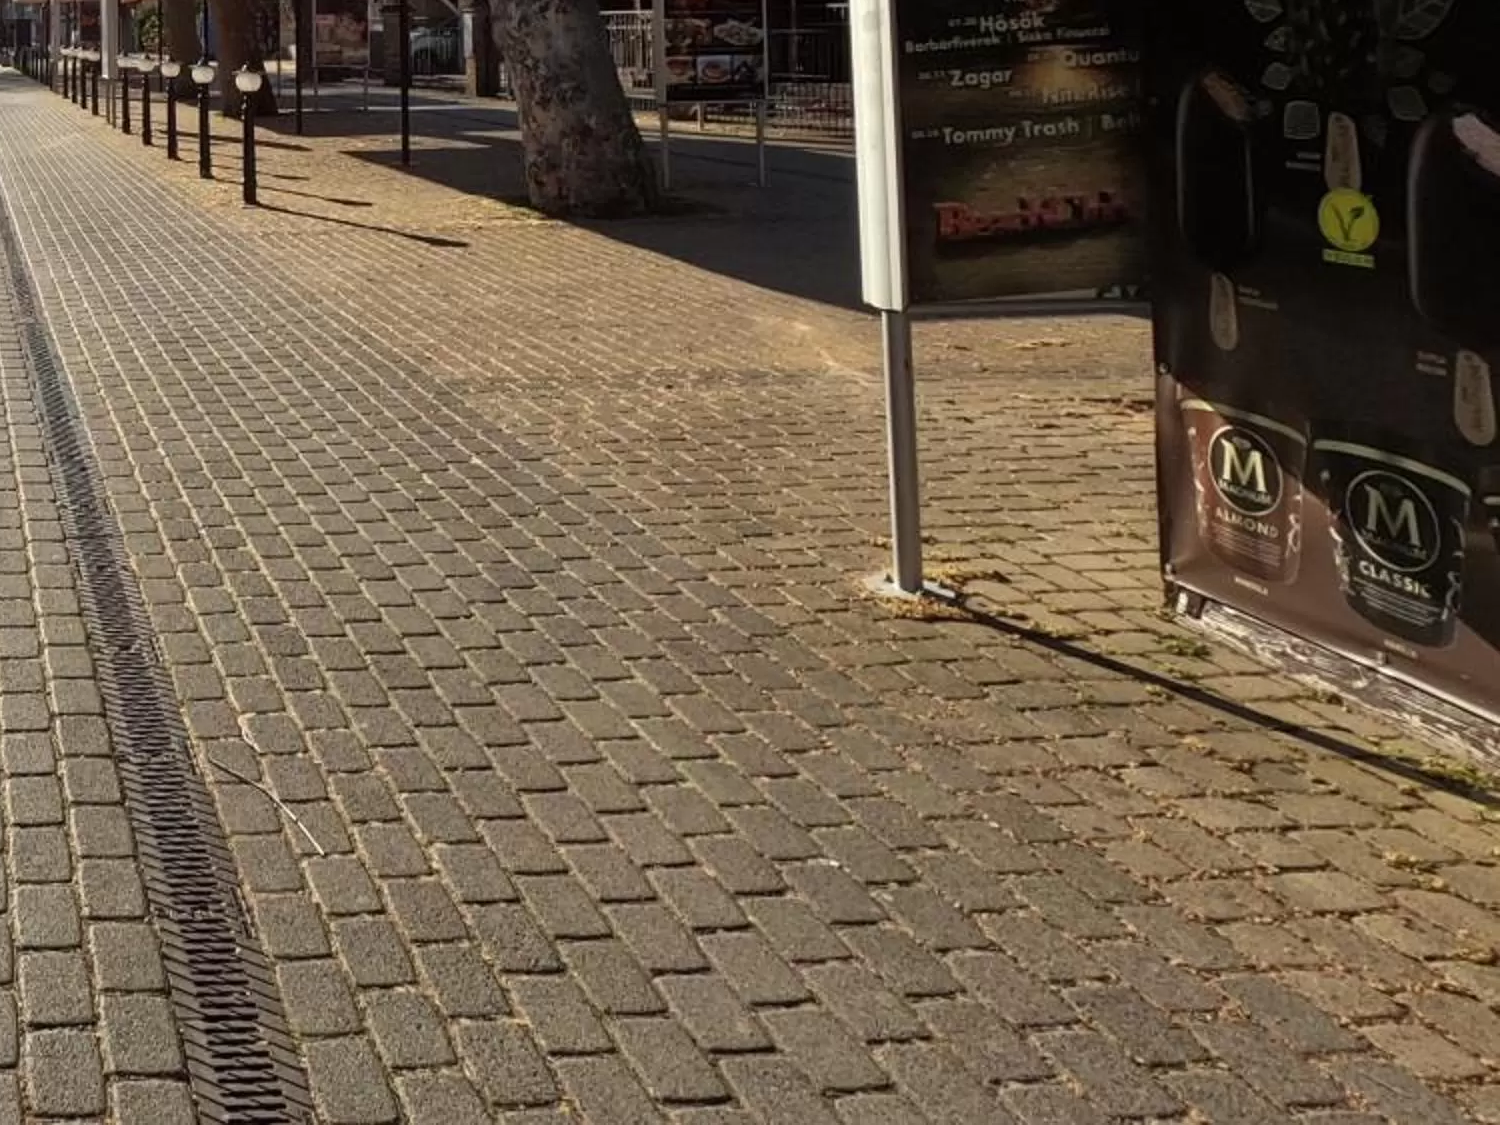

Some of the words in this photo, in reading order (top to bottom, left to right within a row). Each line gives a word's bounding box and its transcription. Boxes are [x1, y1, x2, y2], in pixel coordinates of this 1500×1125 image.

[949, 69, 1012, 89] Zagar
[942, 125, 1016, 145] Tommy
[1021, 116, 1081, 138] Trash
[1221, 438, 1268, 494] M
[1215, 506, 1280, 539] ALMOND
[1364, 484, 1421, 548] M
